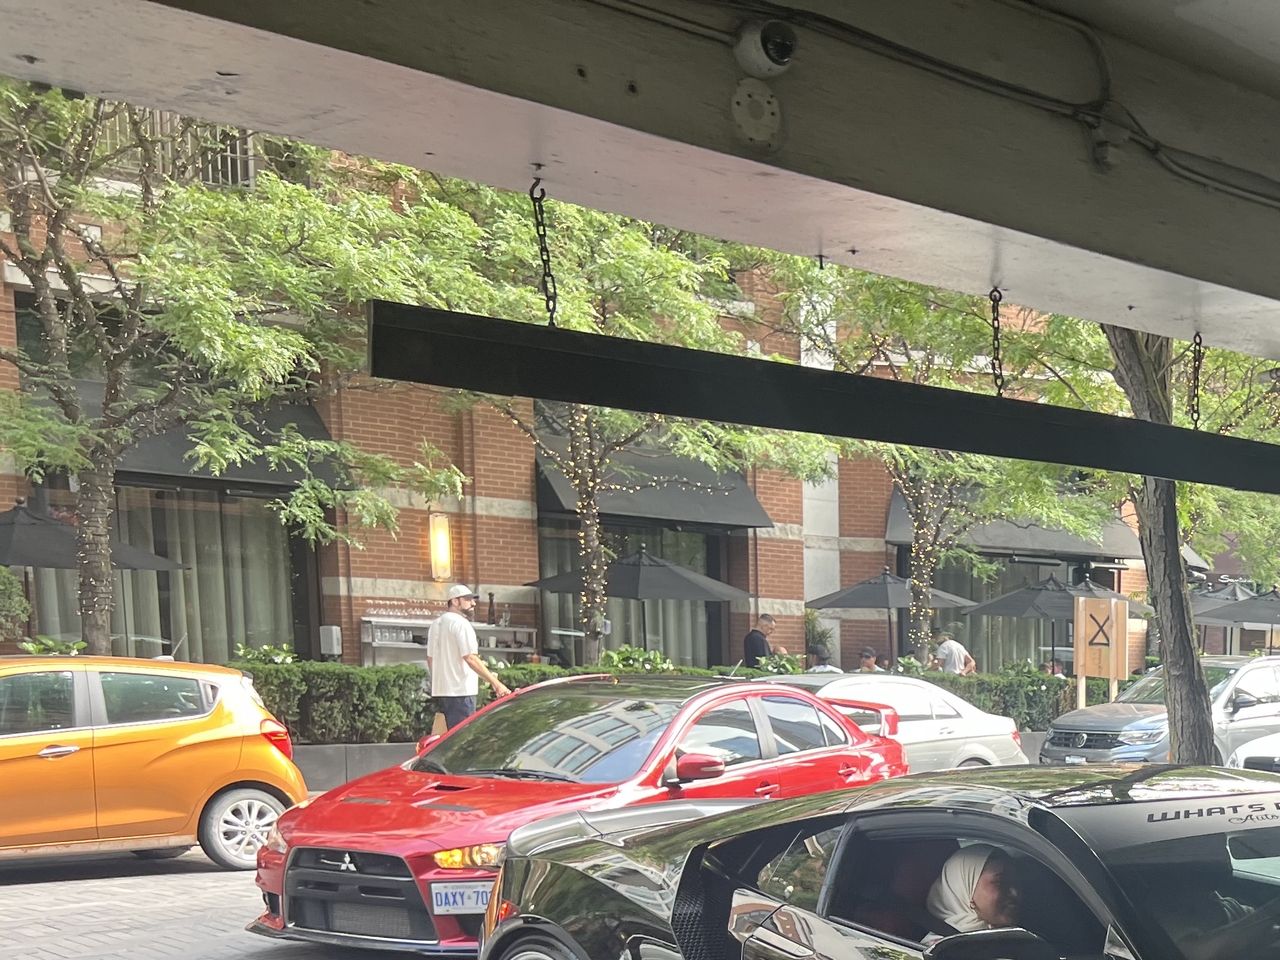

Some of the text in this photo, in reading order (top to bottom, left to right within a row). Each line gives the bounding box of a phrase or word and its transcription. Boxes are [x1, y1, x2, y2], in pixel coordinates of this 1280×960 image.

[1147, 803, 1266, 823] WHATS
[1228, 813, 1280, 824] Auto
[435, 890, 492, 907] DAXY 70
